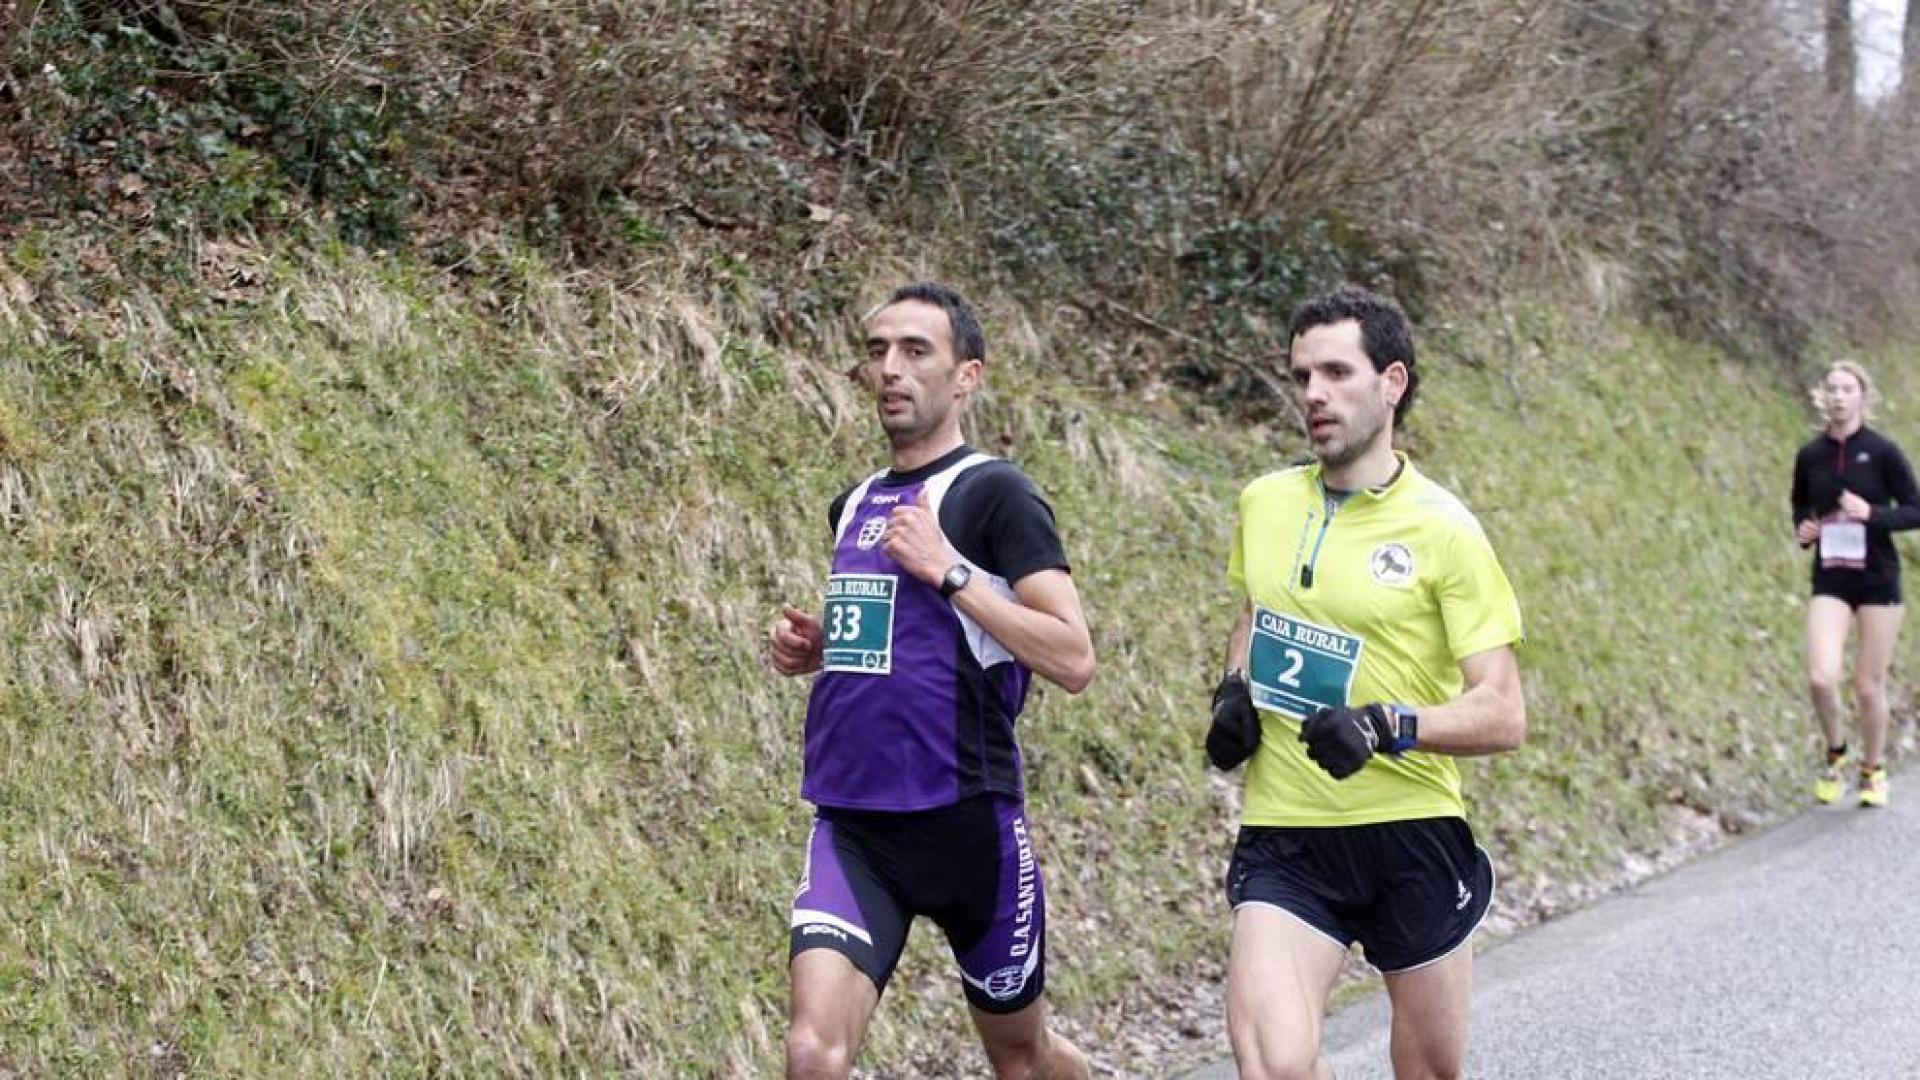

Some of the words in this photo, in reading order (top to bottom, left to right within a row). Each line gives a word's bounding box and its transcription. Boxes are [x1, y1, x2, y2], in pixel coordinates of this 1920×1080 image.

[845, 580, 889, 597] RURAL
[829, 604, 862, 641] 33
[1261, 613, 1292, 639] CAJA
[1293, 625, 1351, 657] RURAL
[1277, 648, 1304, 689] 2
